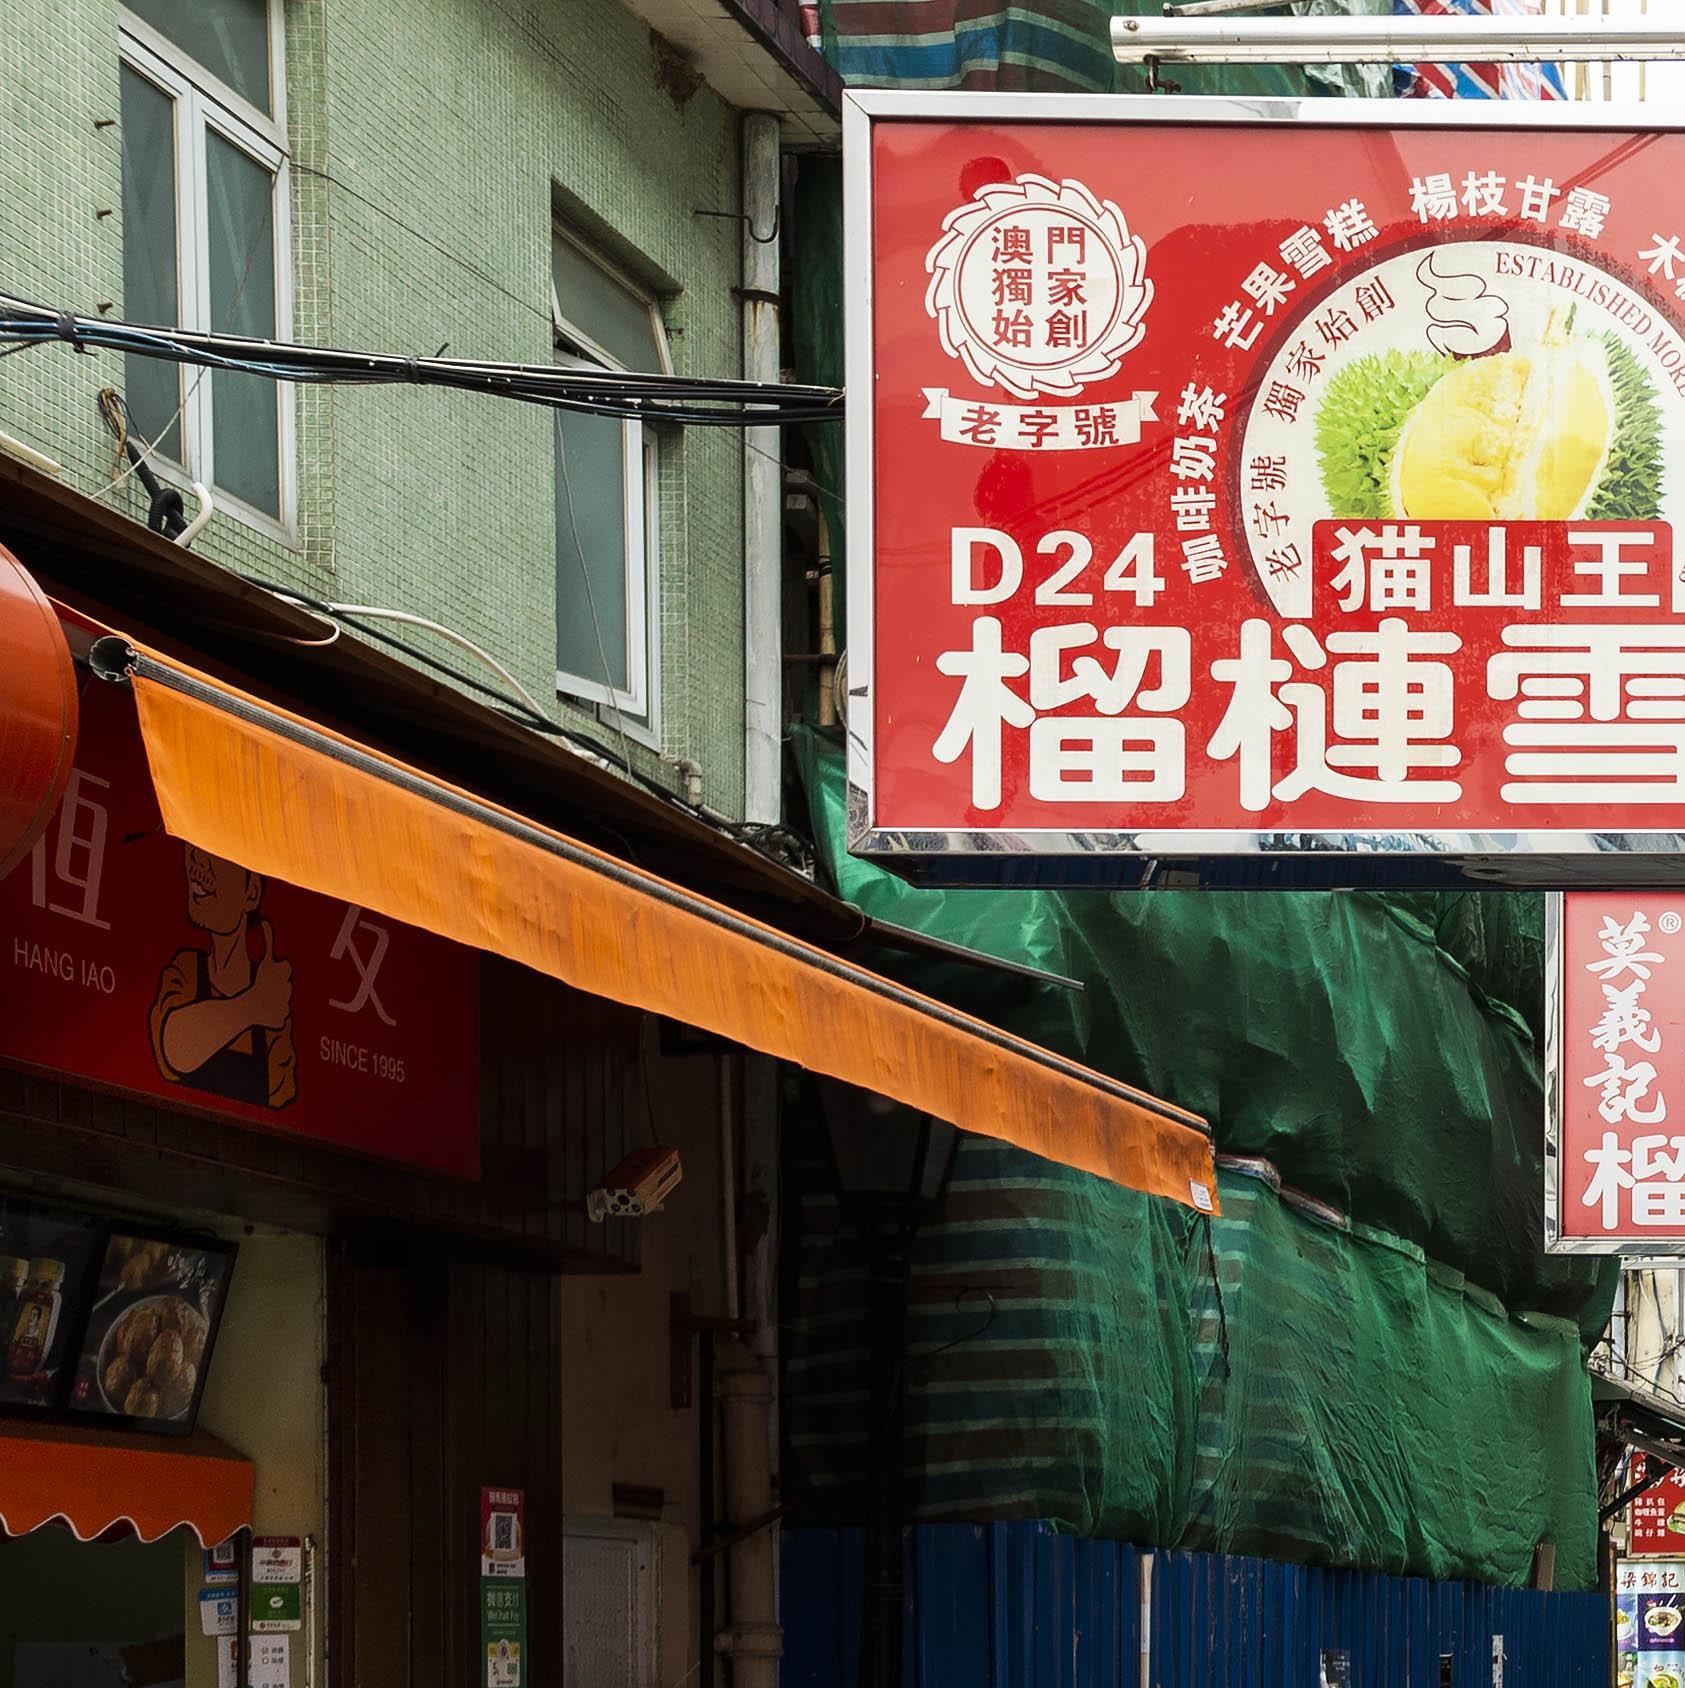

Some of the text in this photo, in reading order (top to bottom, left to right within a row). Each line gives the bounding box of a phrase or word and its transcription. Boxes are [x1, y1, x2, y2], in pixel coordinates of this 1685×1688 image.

[1408, 174, 1613, 241] 楊枝甘露
[1213, 198, 1380, 354] 芒果雪糕
[1494, 250, 1653, 338] ESTABLISHED
[1262, 272, 1397, 427] 獨家始創
[959, 402, 1122, 447] 老字號
[1169, 380, 1230, 585] 咖啡奶茶
[1250, 452, 1303, 585] 老字號
[950, 526, 1165, 610] D24
[1330, 525, 1662, 612] 猫山王
[14, 937, 115, 995] HANG IAO
[319, 1036, 406, 1085] SINCE 1995
[1584, 911, 1668, 1124] 莫義記
[1621, 1572, 1679, 1588] 梁錦記
